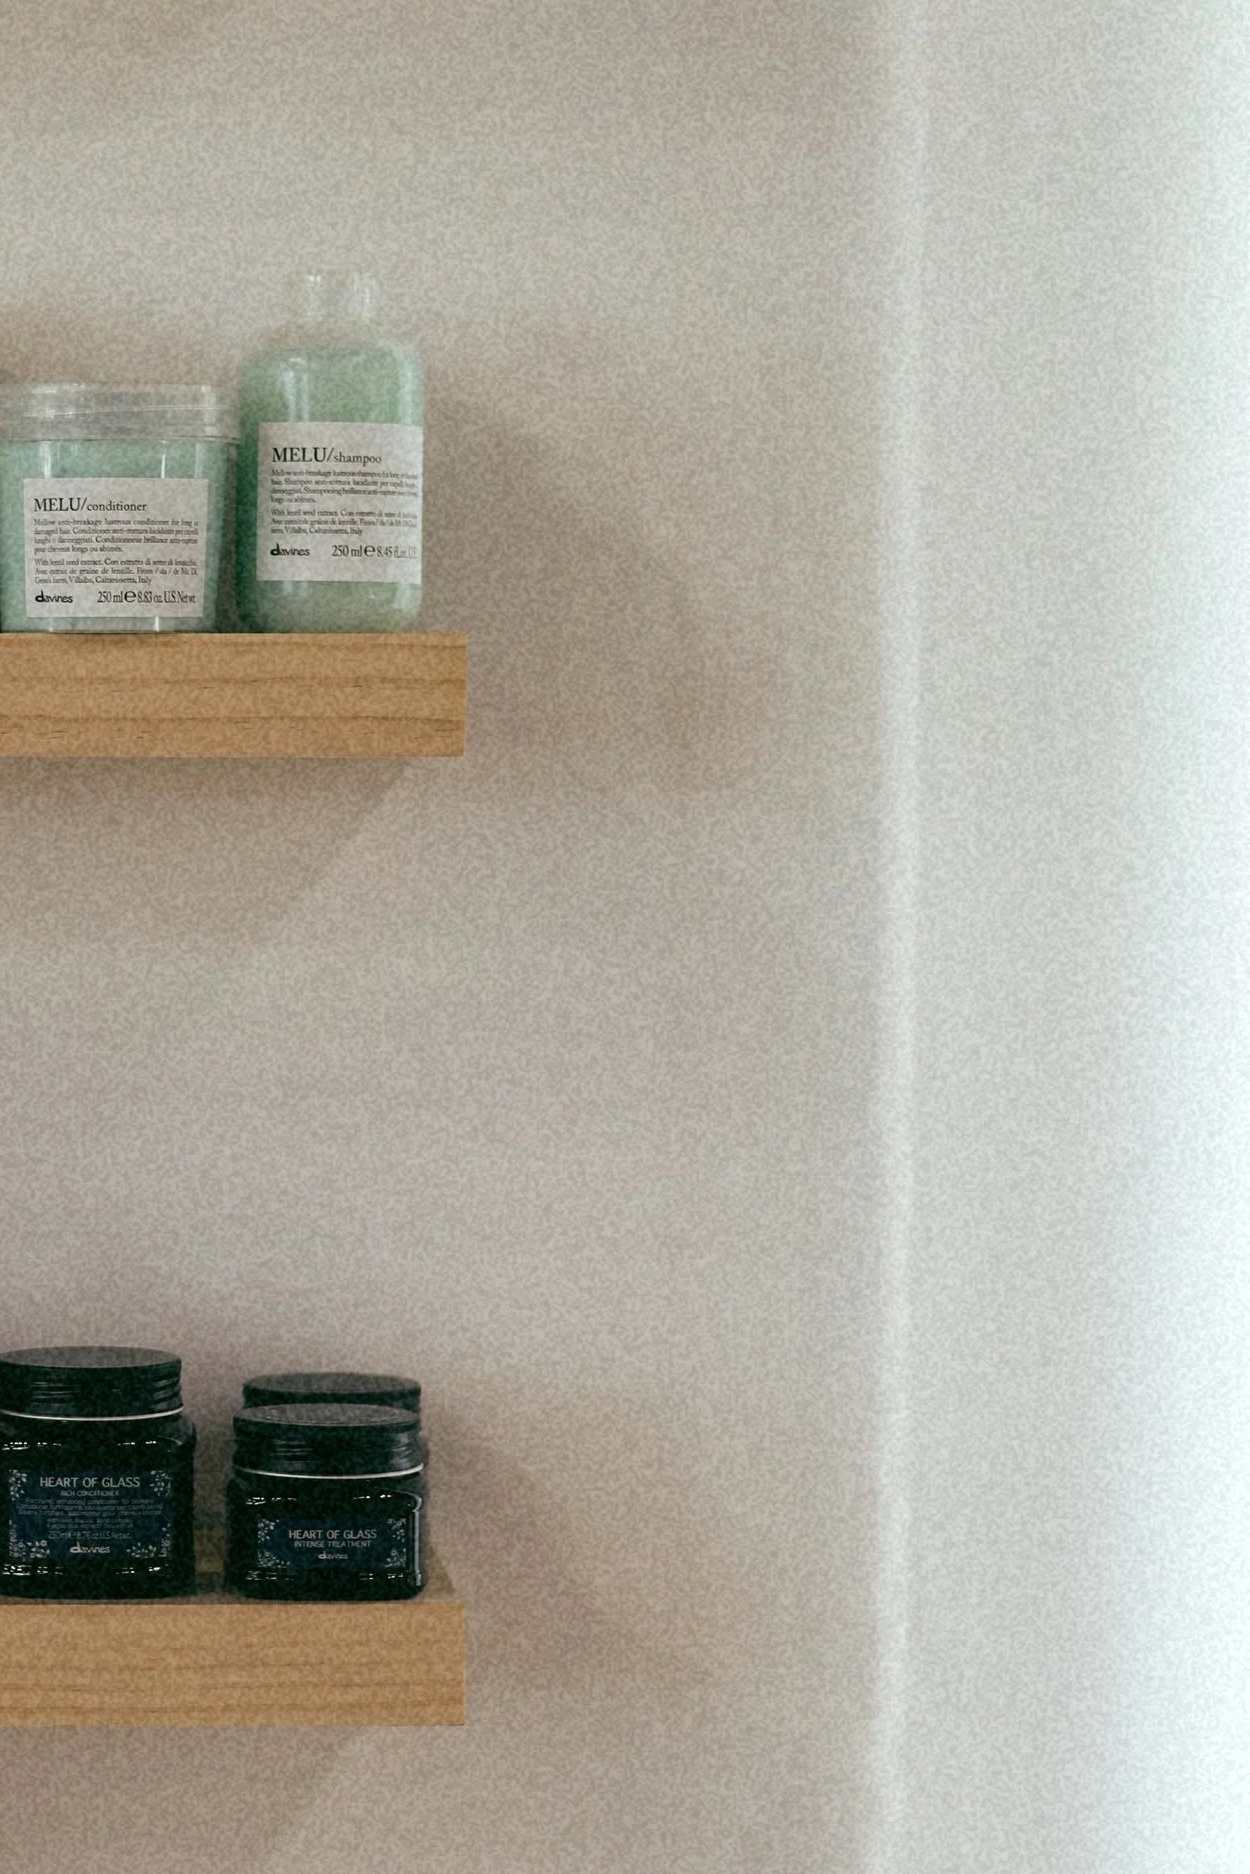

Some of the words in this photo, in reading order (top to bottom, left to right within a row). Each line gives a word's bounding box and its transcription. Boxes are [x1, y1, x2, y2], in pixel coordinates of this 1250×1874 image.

[272, 447, 382, 467] MELU/shampoo
[34, 498, 147, 512] MELU/conditioner
[270, 543, 310, 556] davines
[332, 545, 349, 558] 250
[350, 545, 362, 557] ml
[376, 546, 393, 558] 8.45
[35, 590, 73, 604] davines
[97, 591, 112, 603] 250
[113, 591, 123, 603] ml
[137, 591, 152, 603] 8.83
[40, 1477, 79, 1487] HEART
[82, 1477, 98, 1487] OF
[101, 1477, 141, 1487] GLASS
[288, 1529, 323, 1539] HEART
[326, 1530, 340, 1539] OF
[343, 1529, 377, 1539] GLASS
[69, 1540, 110, 1554] davines
[294, 1540, 325, 1548] INTENSE
[328, 1540, 371, 1548] TREATMENT
